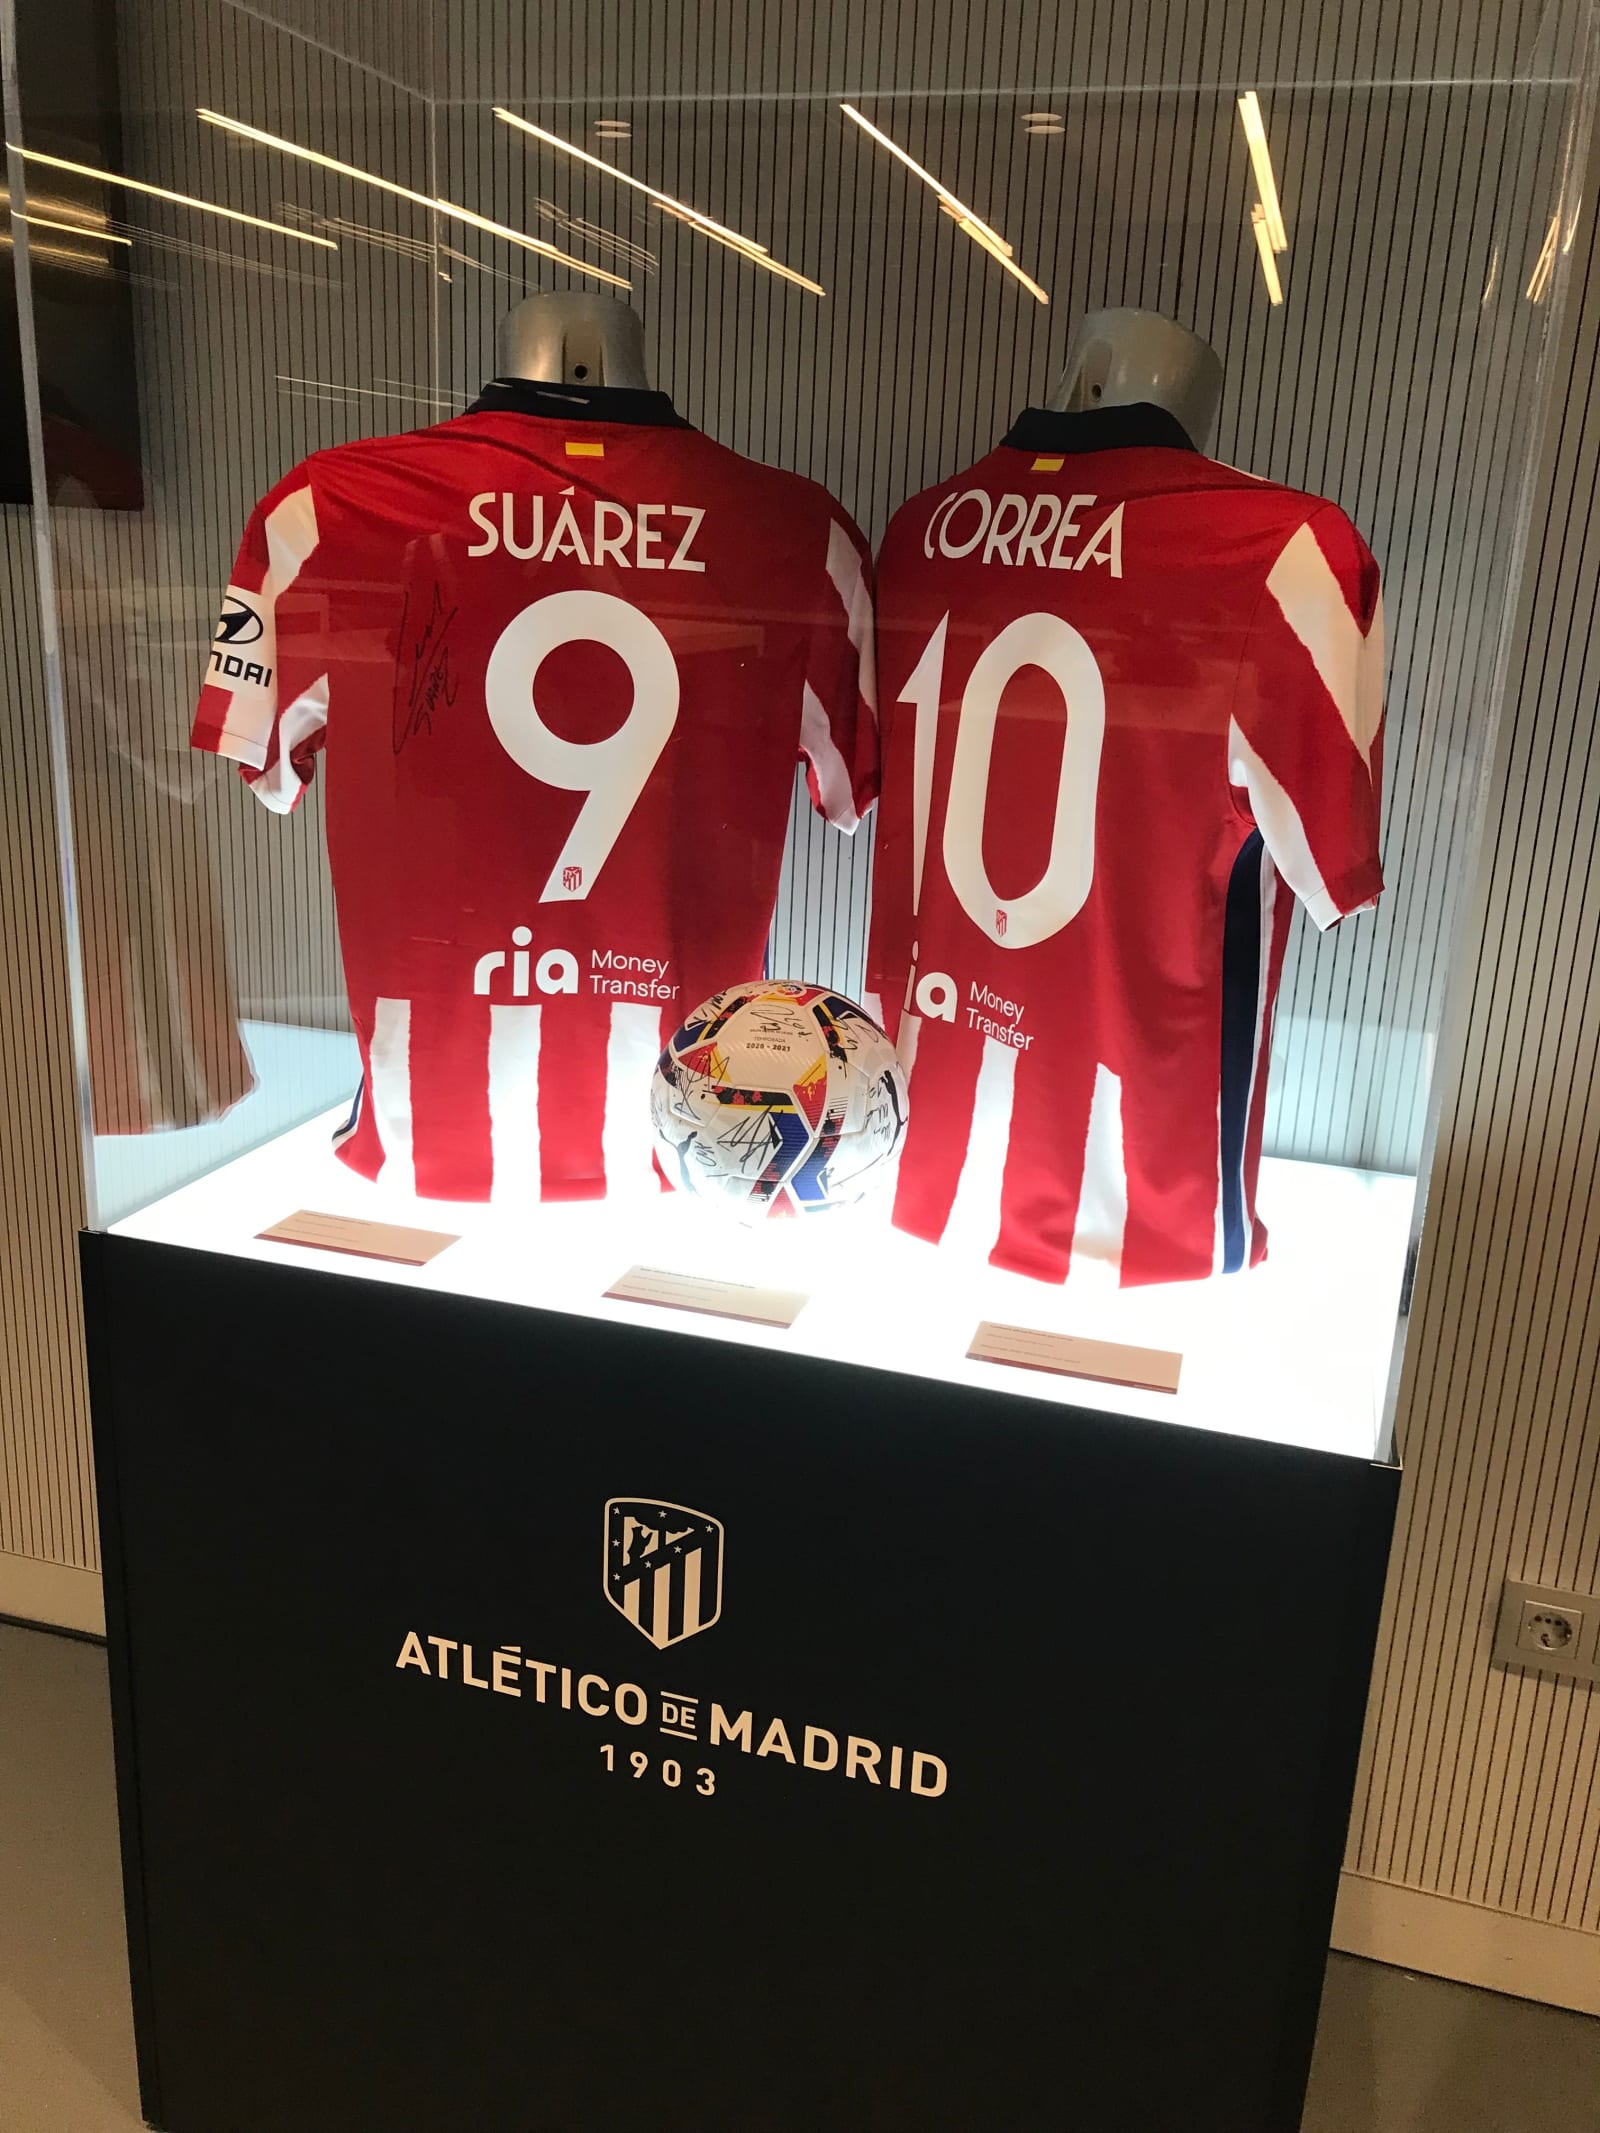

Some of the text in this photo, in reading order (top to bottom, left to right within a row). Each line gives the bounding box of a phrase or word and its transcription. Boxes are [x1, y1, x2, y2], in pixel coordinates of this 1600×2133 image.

[467, 485, 707, 573] SUÁREZ
[923, 488, 1126, 579] CORREA
[485, 590, 681, 904] 9
[896, 608, 1106, 950] 10
[473, 925, 580, 997] ria
[589, 974, 681, 1000] Transfer
[590, 949, 670, 979] Money
[965, 1007, 1035, 1051] Transfer
[969, 981, 1025, 1025] Money
[395, 1631, 948, 1798] ATLÉTICO DE MADRID
[600, 1743, 717, 1796] 1903
